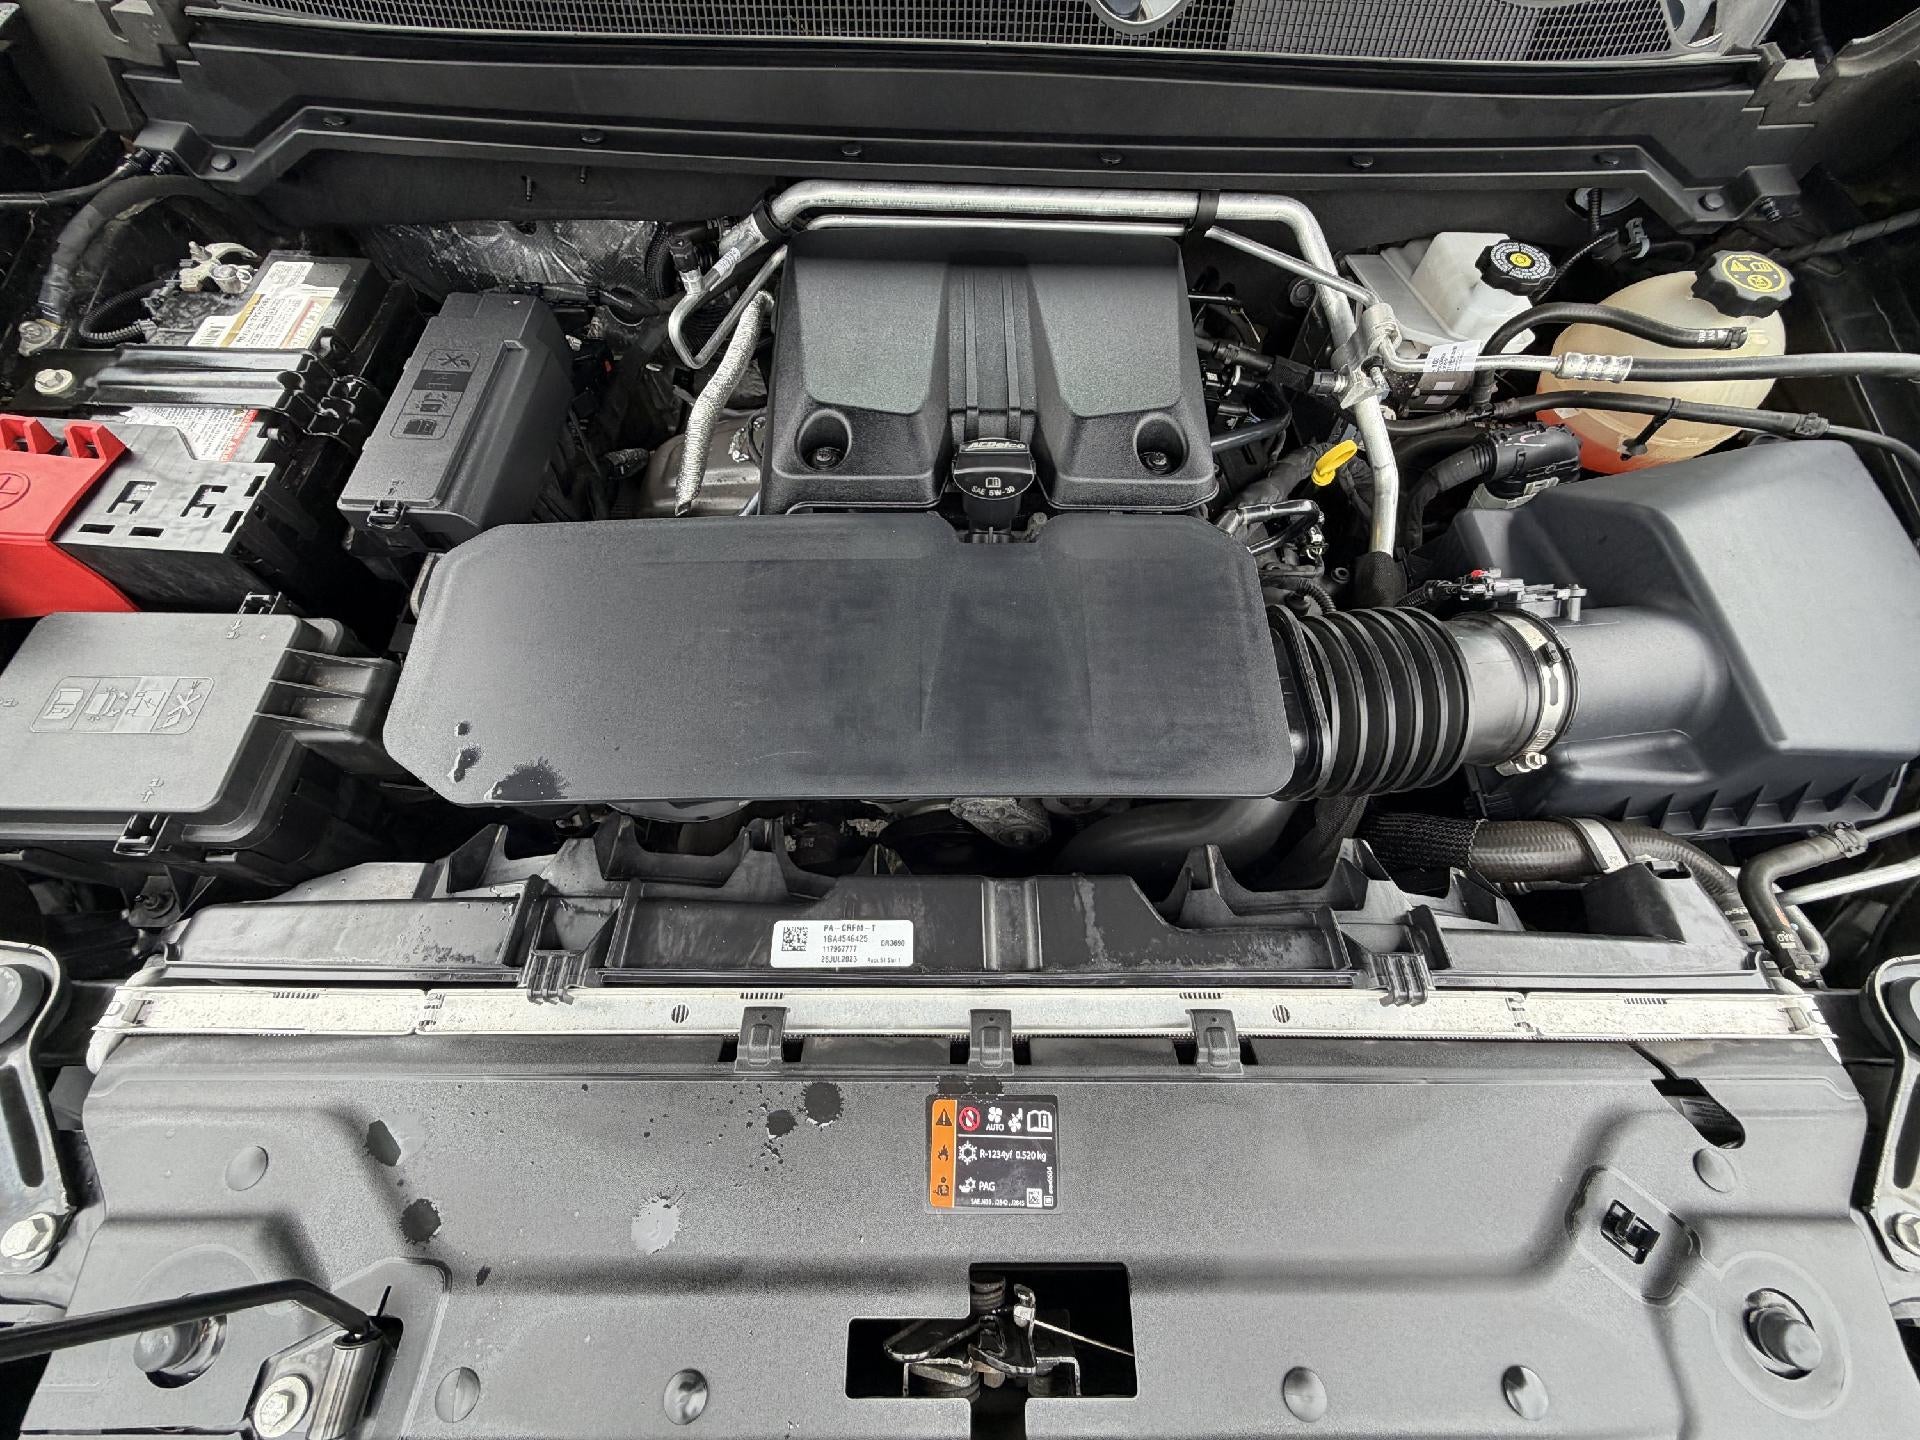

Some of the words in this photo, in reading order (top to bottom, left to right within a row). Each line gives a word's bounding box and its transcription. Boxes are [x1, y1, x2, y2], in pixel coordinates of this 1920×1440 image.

[967, 441, 1026, 449] ACDelco
[971, 485, 986, 495] SAE
[988, 485, 1016, 496] 5W-30
[985, 1123, 1005, 1132] AUTO
[979, 1149, 1013, 1161] R-1234yf
[978, 1181, 996, 1191] PAG
